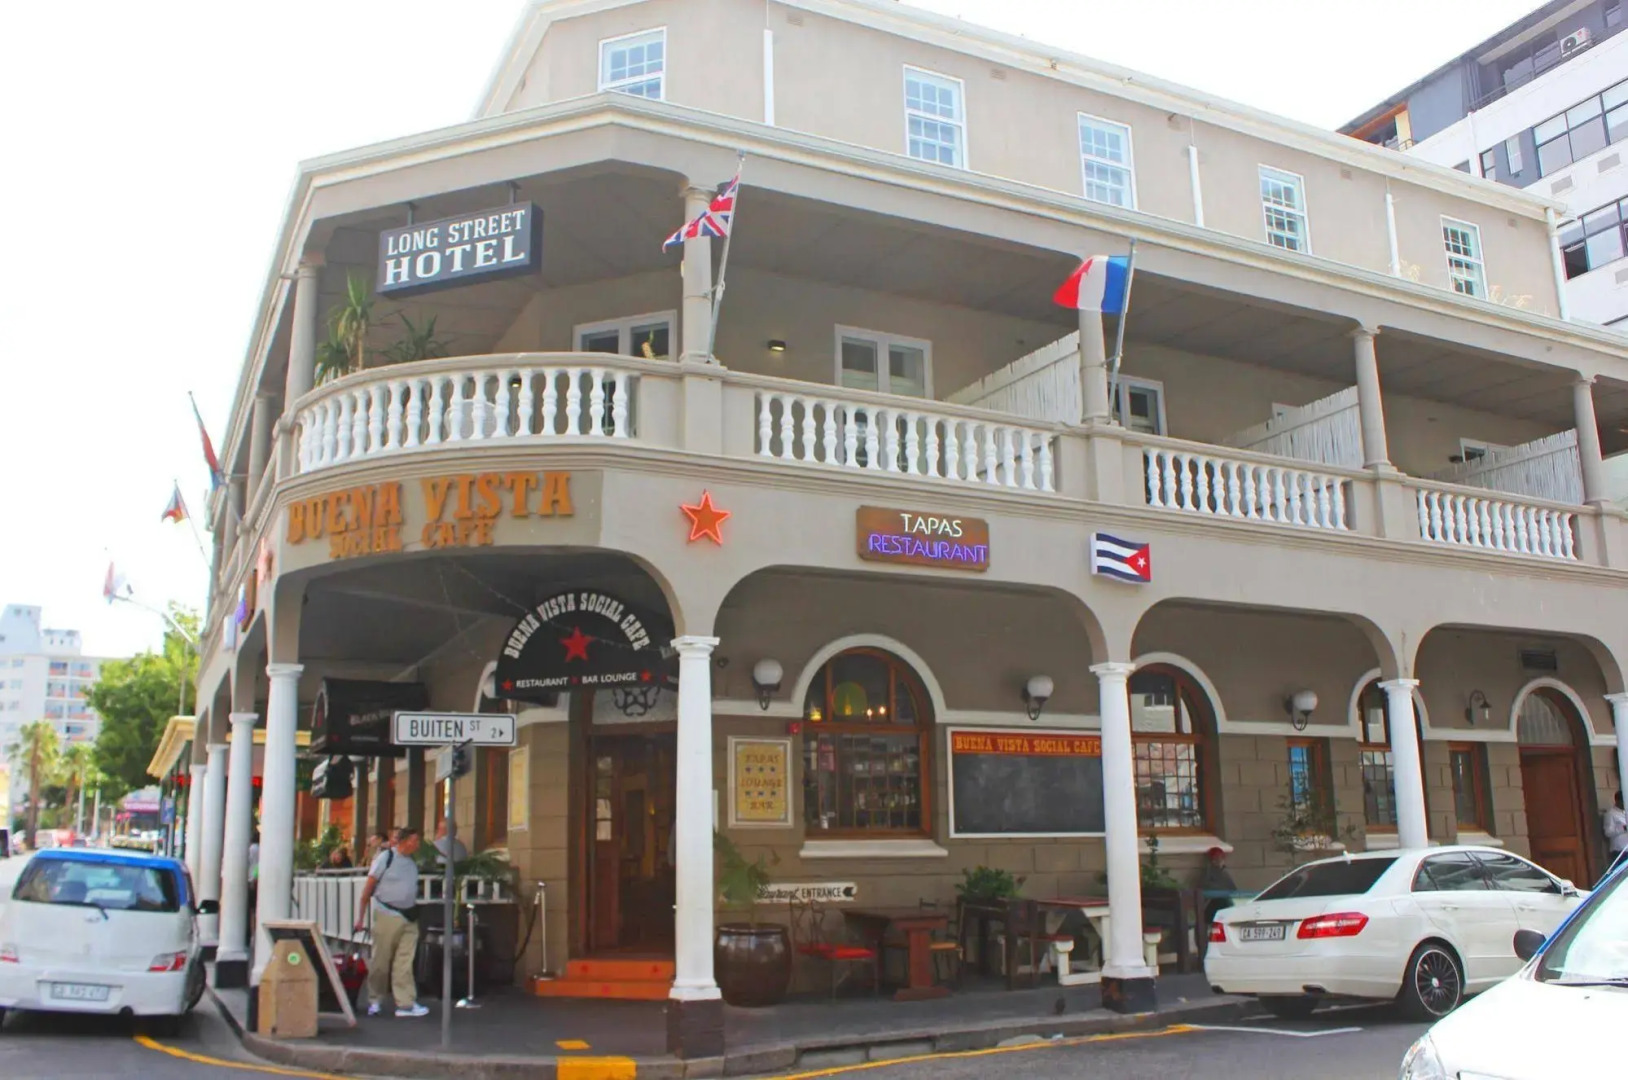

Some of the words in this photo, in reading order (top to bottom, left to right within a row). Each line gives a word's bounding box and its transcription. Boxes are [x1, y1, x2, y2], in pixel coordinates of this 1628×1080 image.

[387, 227, 439, 256] LONG
[448, 209, 525, 243] STREET
[384, 235, 525, 286] HOTEL
[286, 480, 403, 545] BUENA
[420, 471, 574, 521] VISTA
[900, 513, 963, 537] TAPAS
[329, 526, 403, 558] SOCIAL
[868, 533, 988, 563] RESTAURANT
[504, 612, 541, 659] BUENA
[536, 593, 576, 622] VISTA
[579, 592, 624, 622] SOCIAL
[516, 676, 569, 688] RESTAURANT
[582, 674, 599, 685] BAR
[601, 671, 637, 683] LOUNGE
[410, 719, 463, 738] BUITEN
[470, 720, 481, 731] ST
[955, 736, 993, 750] BUENA
[997, 739, 1028, 752] VISTA
[1033, 740, 1071, 753] SOCIAL
[801, 887, 842, 899] ENTRANCE
